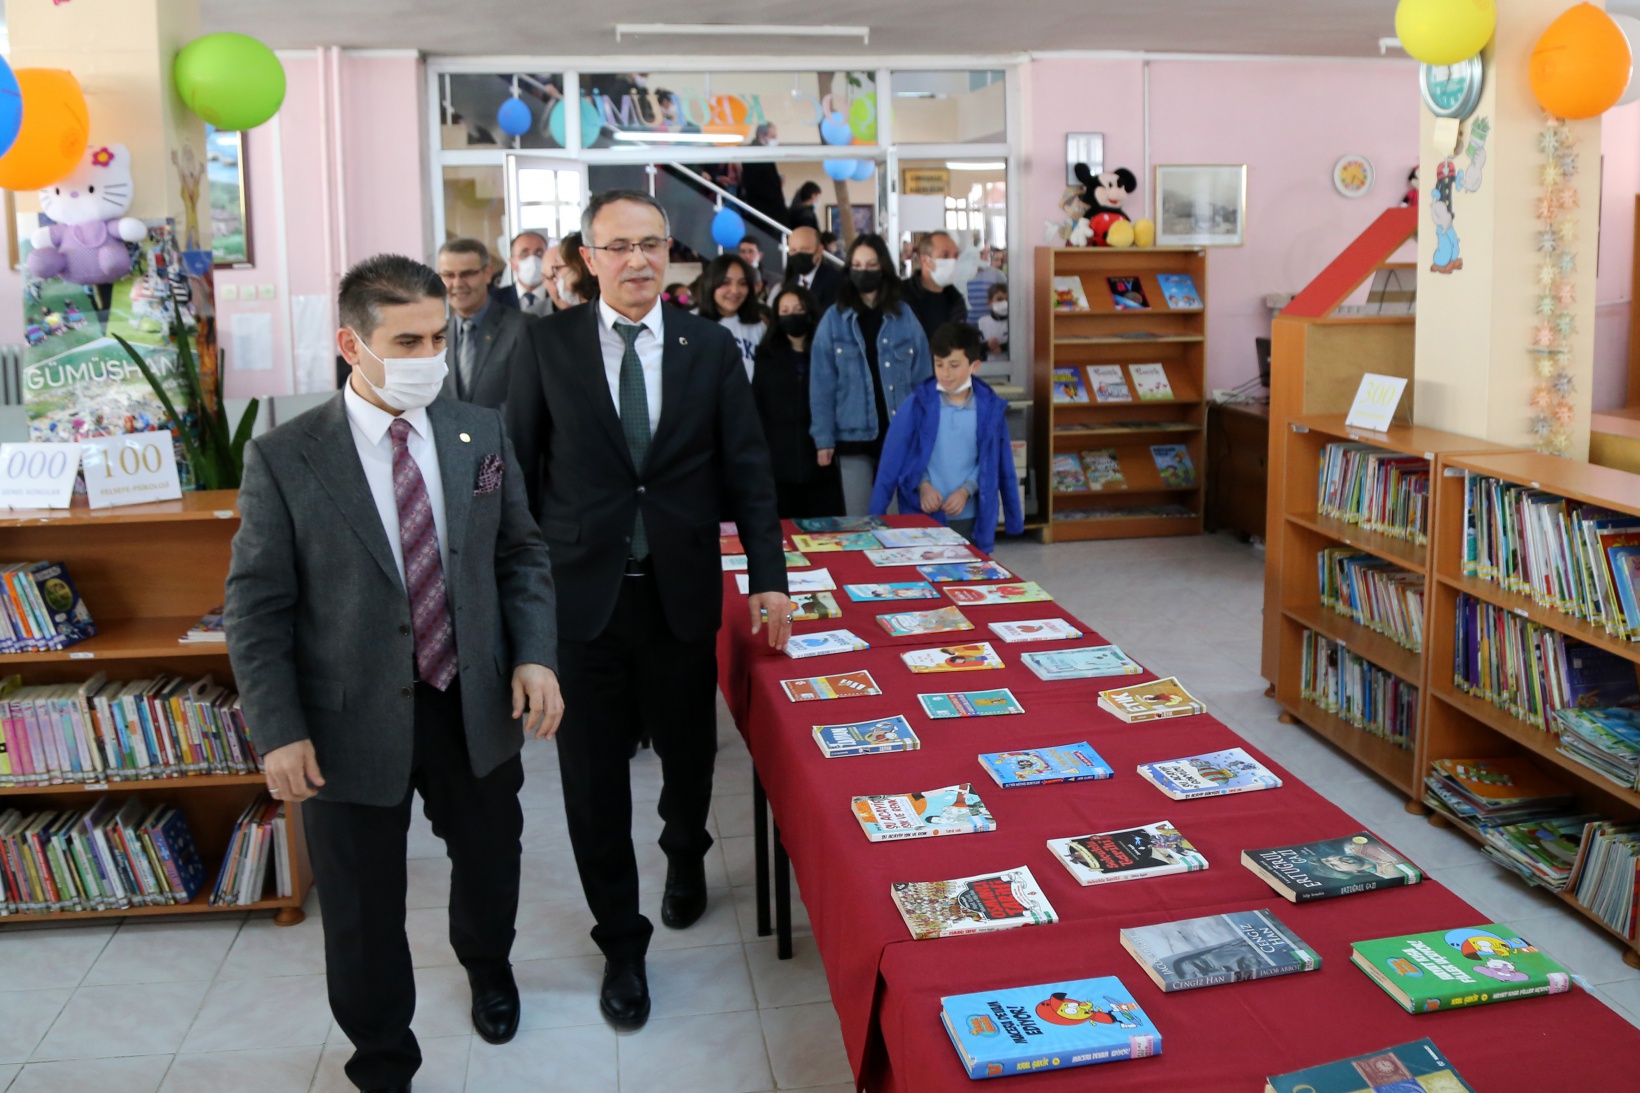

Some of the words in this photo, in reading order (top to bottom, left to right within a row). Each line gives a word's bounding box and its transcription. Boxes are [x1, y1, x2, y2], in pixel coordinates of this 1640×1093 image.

[27, 355, 179, 390] GÜMÜŞHAN
[1360, 381, 1397, 408] 300
[7, 450, 67, 479] 000
[101, 443, 162, 479] 100
[1257, 850, 1322, 887] ERTUĞRUL
[1240, 924, 1275, 954] CENGİZ
[1259, 927, 1285, 946] HAN
[1206, 975, 1225, 985] HAN
[1260, 968, 1279, 977] JACOB
[987, 1001, 1010, 1020] DEVAM
[1006, 1006, 1043, 1035] EDİYOR!
[1001, 1021, 1028, 1044] MACERA
